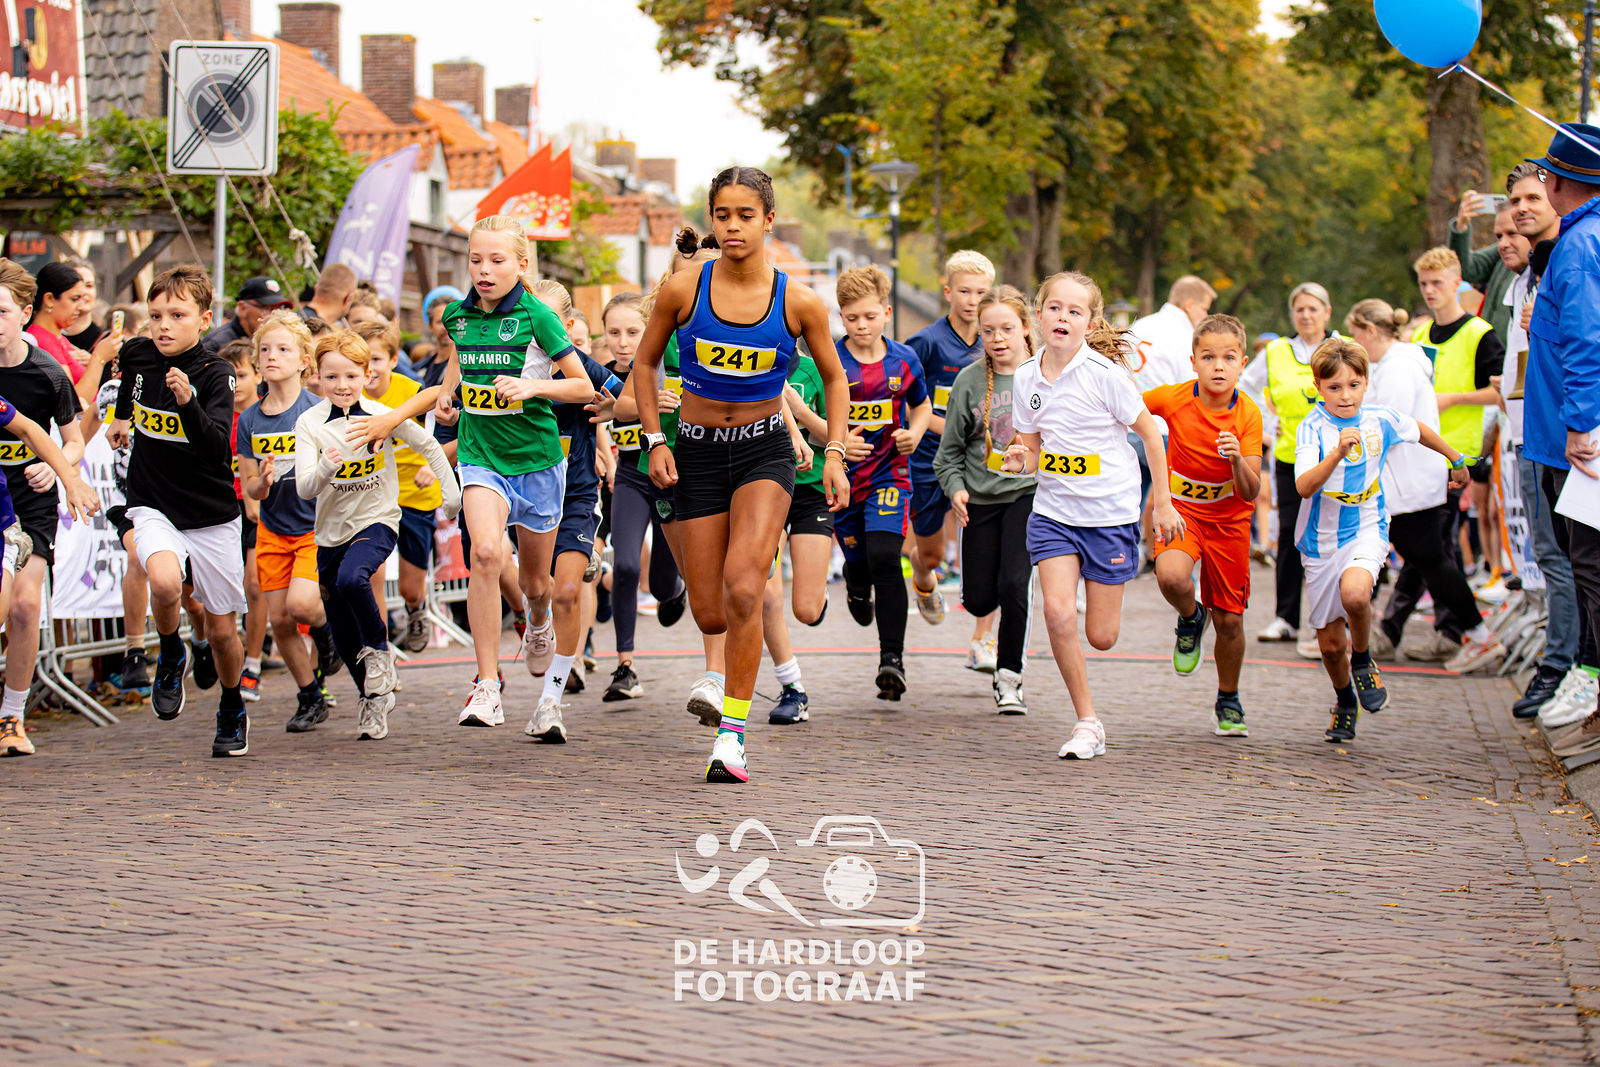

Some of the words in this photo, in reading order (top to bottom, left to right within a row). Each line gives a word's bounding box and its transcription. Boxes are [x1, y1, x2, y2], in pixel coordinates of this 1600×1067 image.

[201, 53, 243, 66] ZONE
[709, 346, 760, 371] 241
[140, 409, 180, 435] 239
[848, 404, 883, 421] 229
[713, 418, 767, 442] NIKE
[258, 435, 296, 454] 242
[334, 457, 376, 479] 225
[1044, 453, 1088, 475] 233
[876, 486, 900, 507] 10
[1181, 480, 1224, 500] 227
